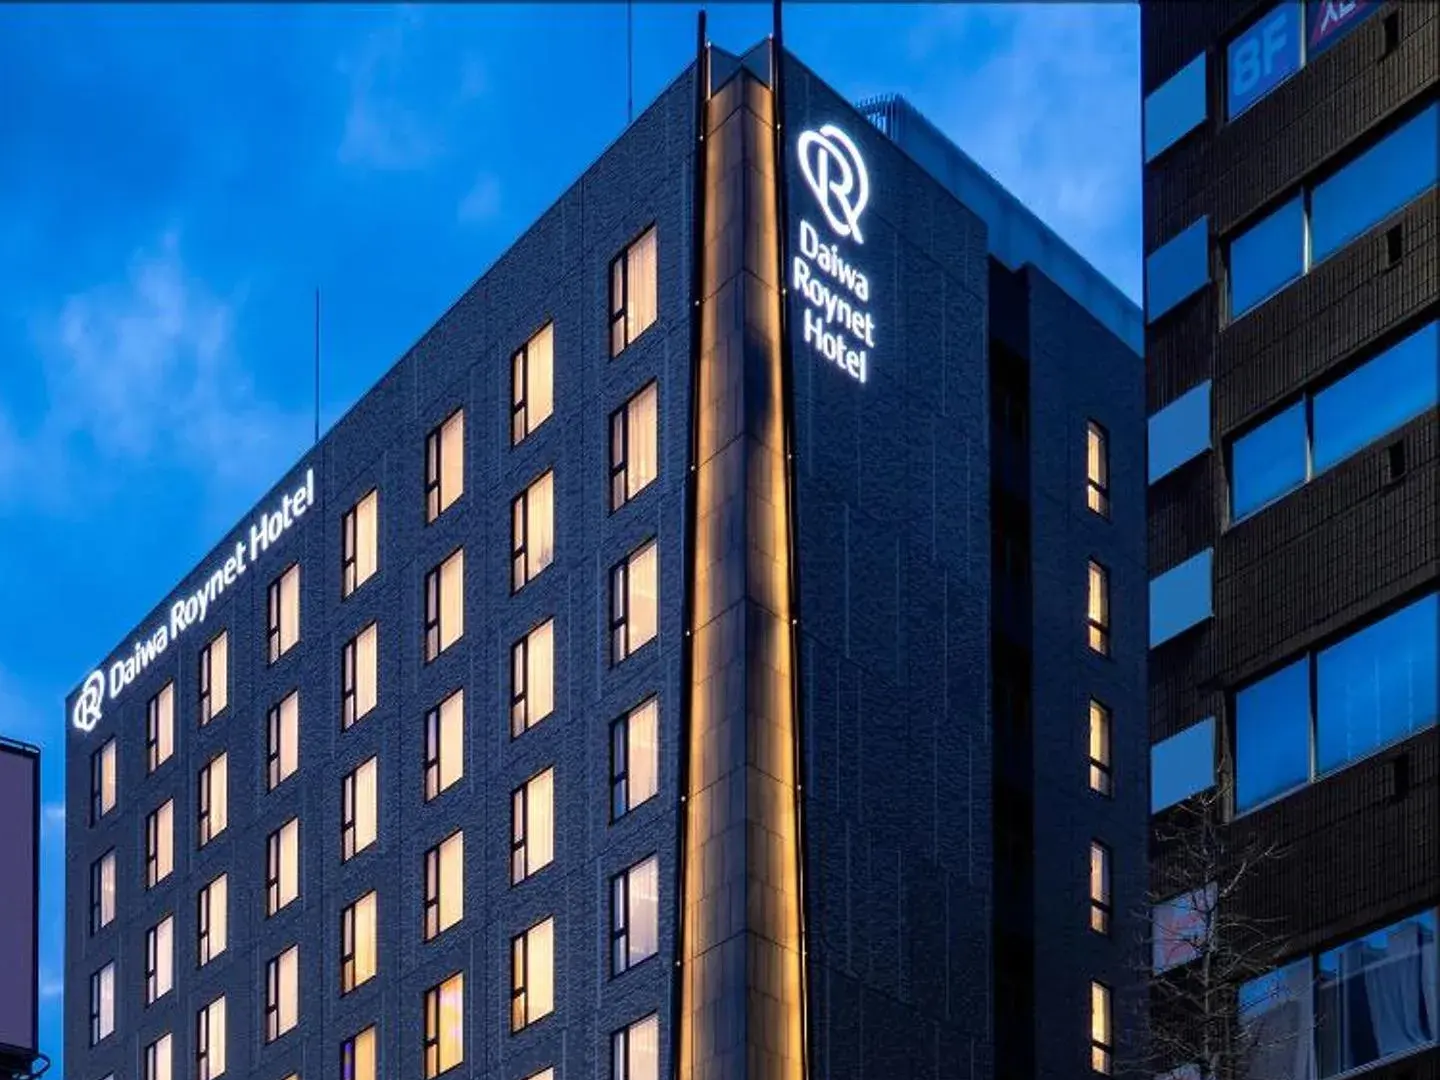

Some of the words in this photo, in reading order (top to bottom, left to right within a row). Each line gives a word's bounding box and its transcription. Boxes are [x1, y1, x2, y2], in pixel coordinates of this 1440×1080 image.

[793, 257, 875, 348] Roynet
[799, 219, 869, 302] Daiwa
[803, 309, 867, 383] Hotel
[109, 623, 168, 699] Daiwa
[170, 542, 246, 640] Roynet
[248, 468, 315, 562] Hotel
